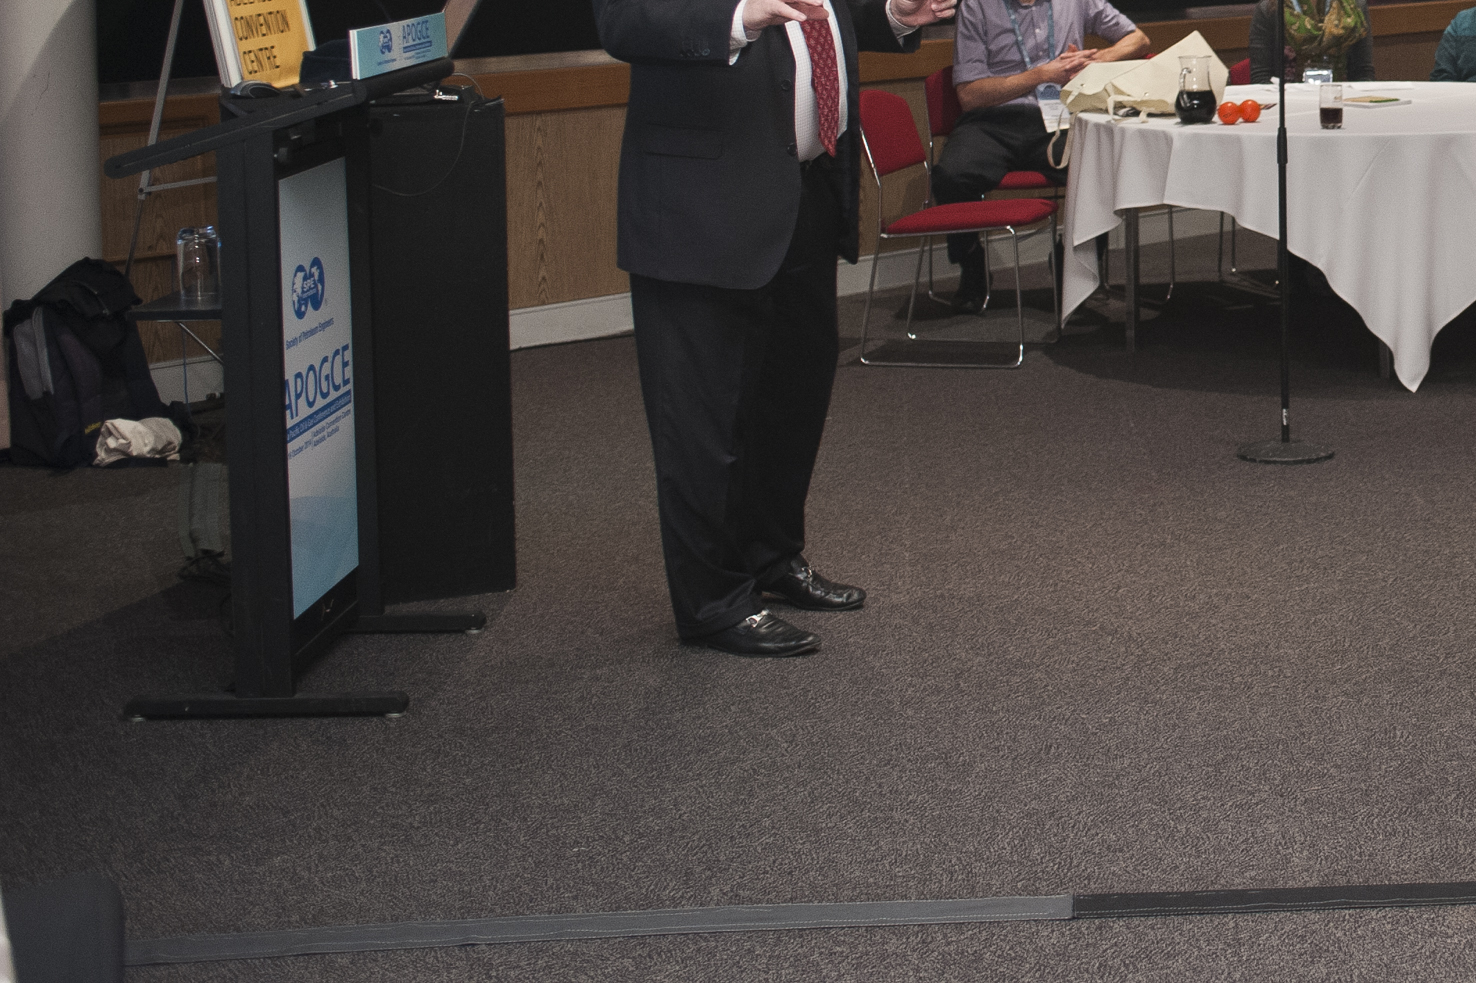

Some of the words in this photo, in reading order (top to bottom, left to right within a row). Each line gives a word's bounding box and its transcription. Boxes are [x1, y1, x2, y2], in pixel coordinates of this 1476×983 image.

[234, 9, 290, 42] CONVENTION
[402, 19, 430, 45] APOGCE
[243, 45, 280, 75] CENTRE
[303, 276, 316, 292] SPE
[285, 343, 350, 420] APOGCE
